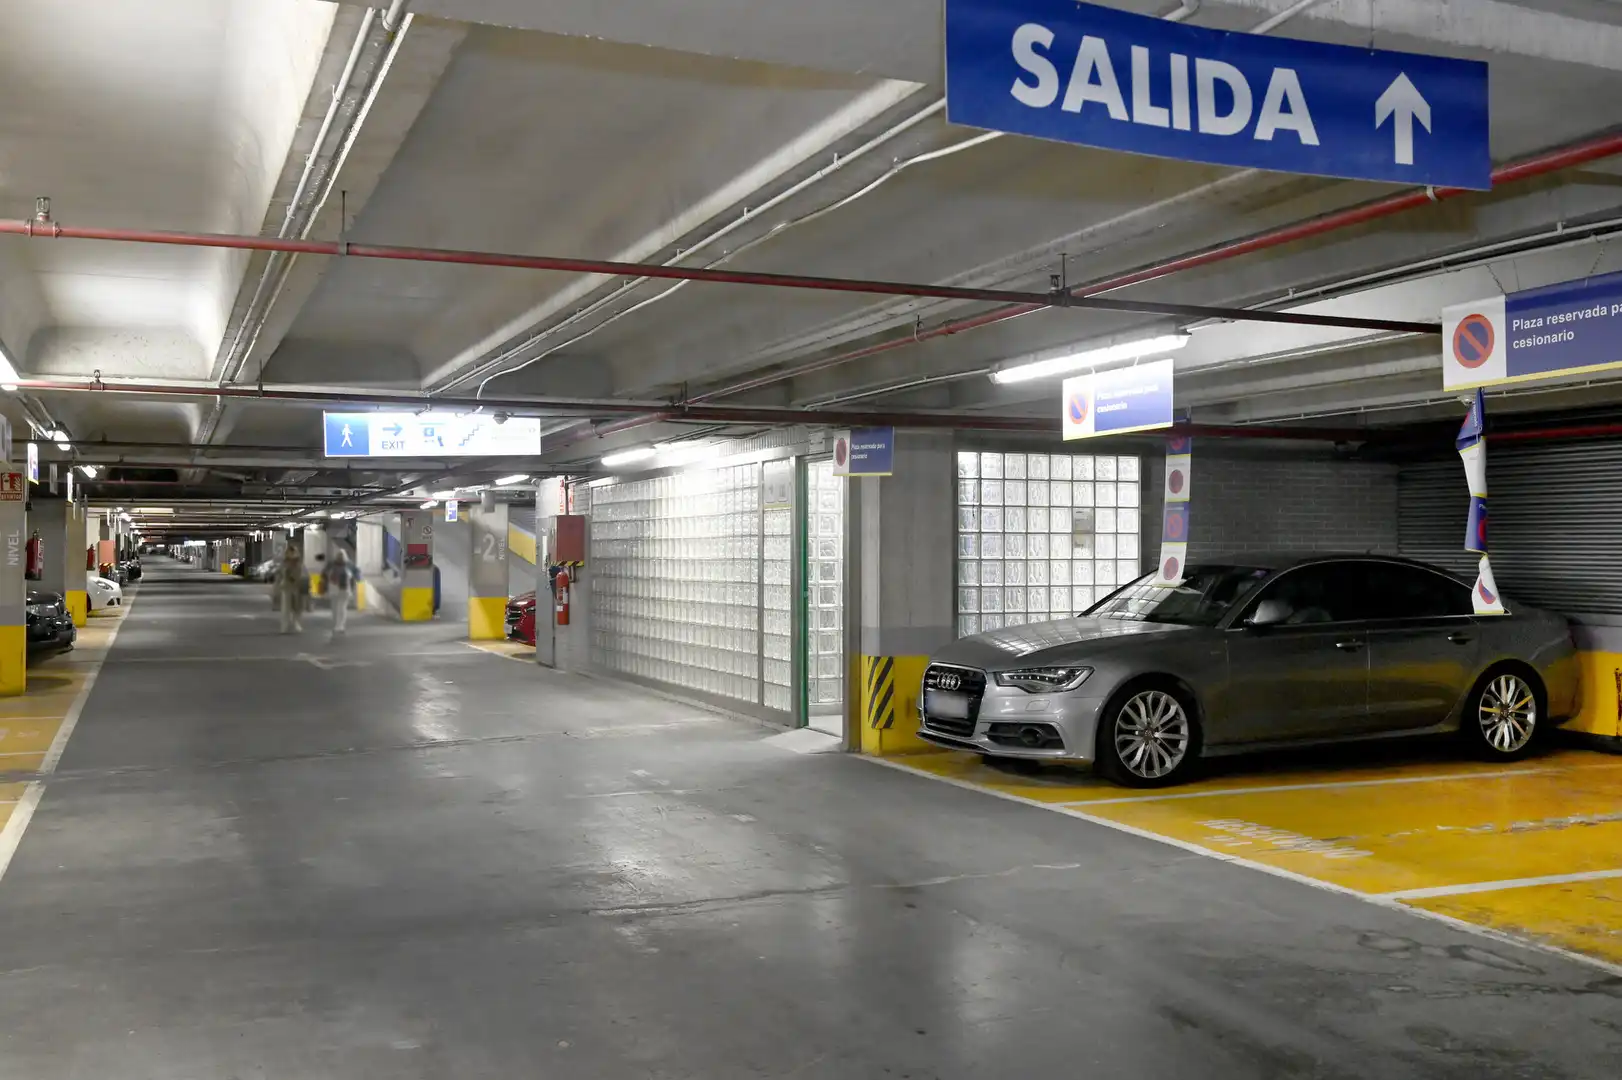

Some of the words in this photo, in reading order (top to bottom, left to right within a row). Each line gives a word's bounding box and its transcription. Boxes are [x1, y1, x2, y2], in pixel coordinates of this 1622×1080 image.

[1010, 22, 1321, 146] SALIDA
[1512, 318, 1543, 331] Plaza
[1546, 304, 1608, 325] reservada
[1512, 329, 1575, 349] cesionario
[381, 440, 405, 450] EXIT
[7, 530, 20, 566] NIVEL
